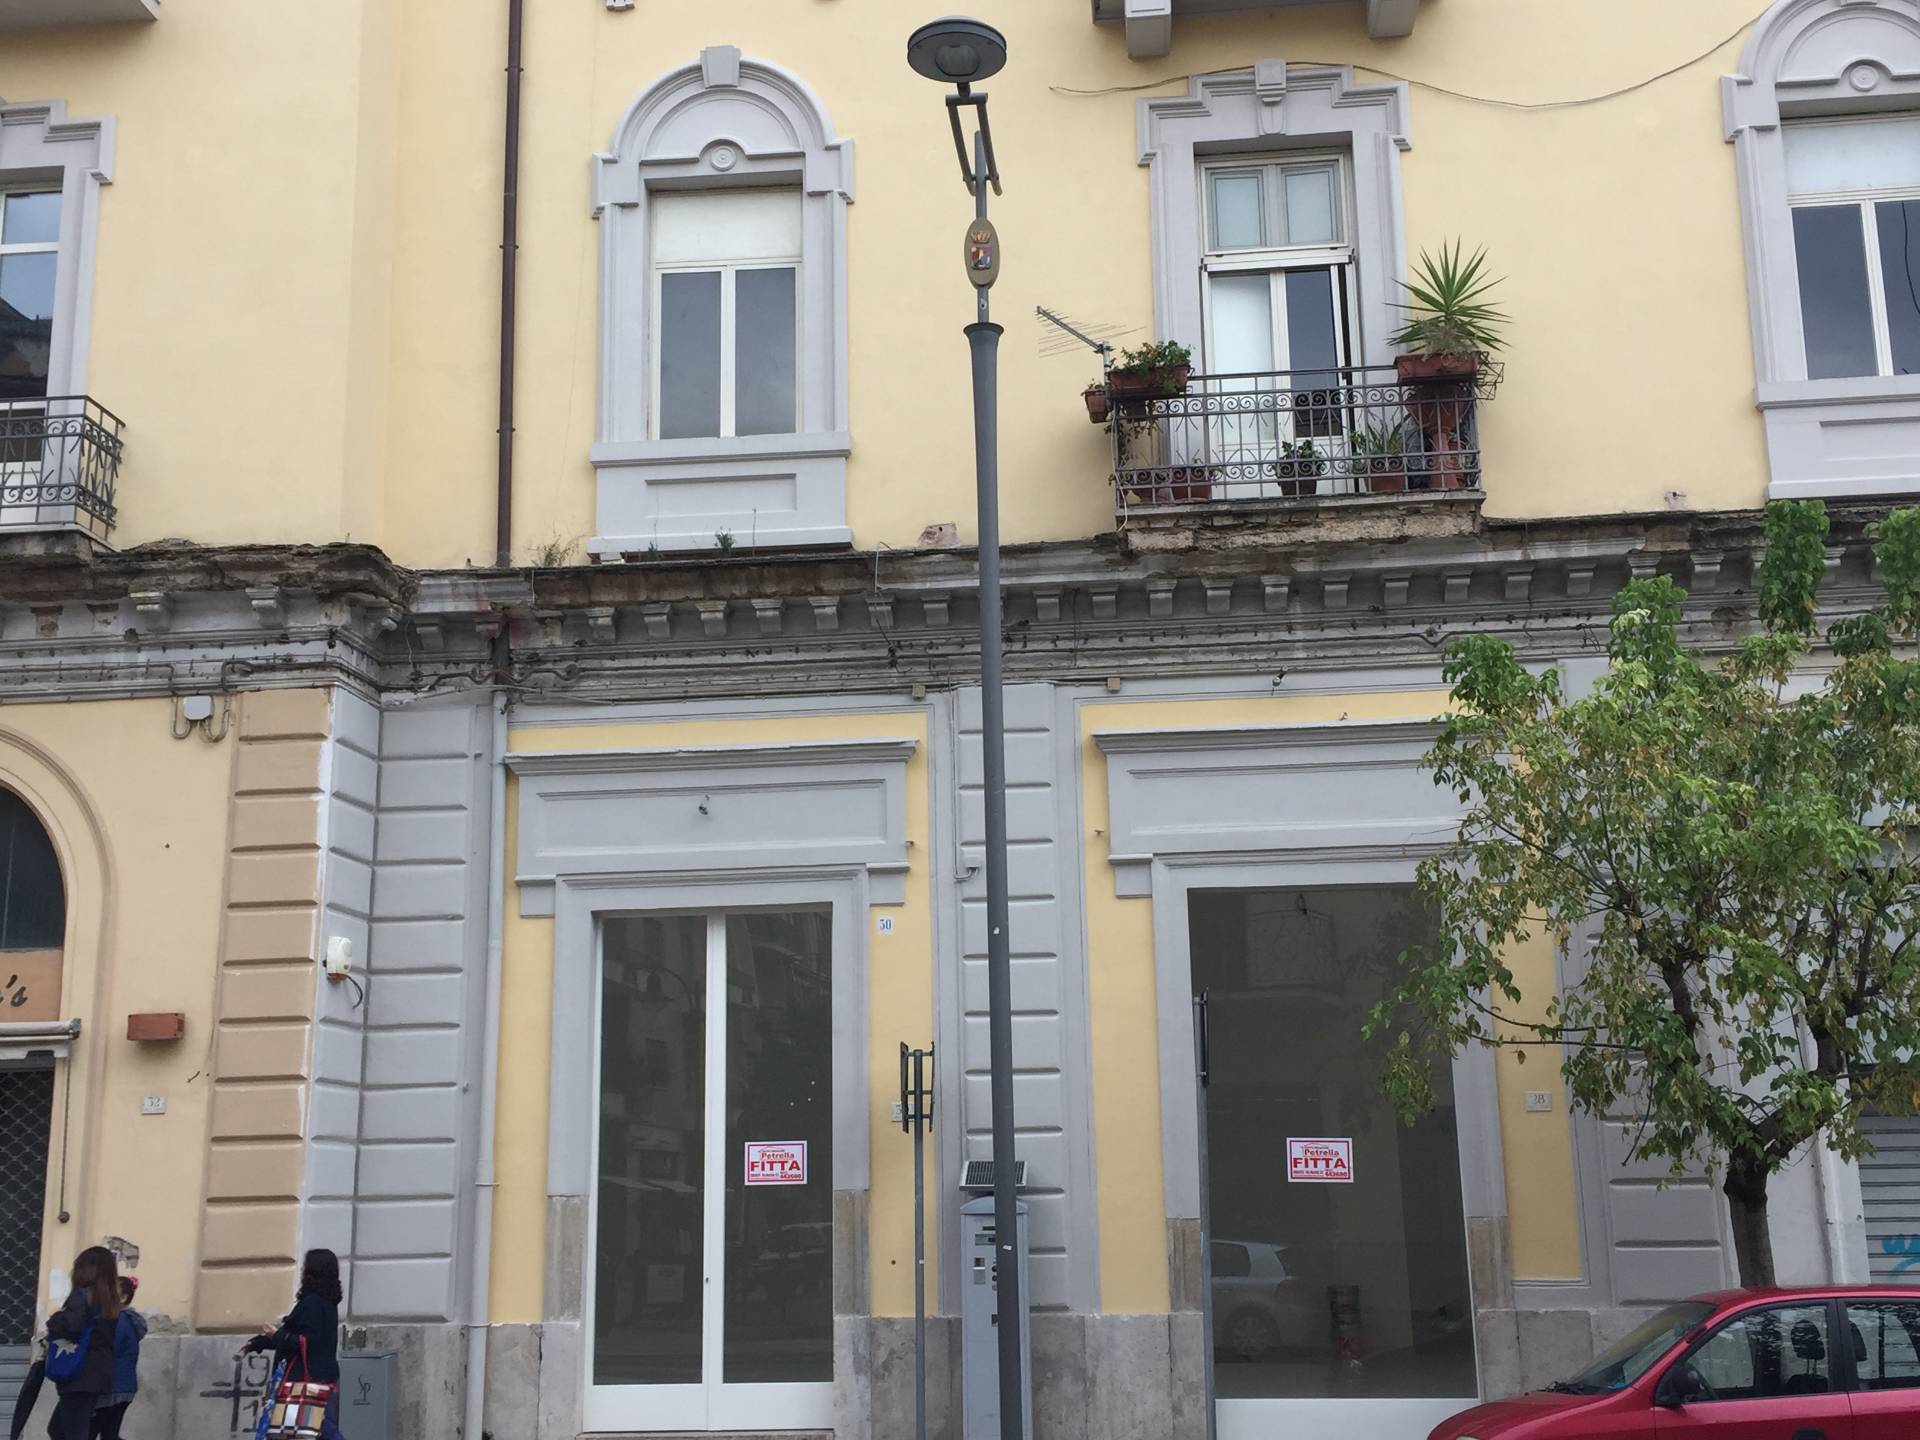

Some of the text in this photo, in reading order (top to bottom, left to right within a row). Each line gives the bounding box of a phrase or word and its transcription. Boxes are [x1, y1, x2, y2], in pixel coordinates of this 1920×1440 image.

[761, 1152, 795, 1160] Petrella
[1304, 1148, 1340, 1157] Petrella
[750, 1160, 801, 1172] FITTA
[1292, 1157, 1347, 1169] FITTA
